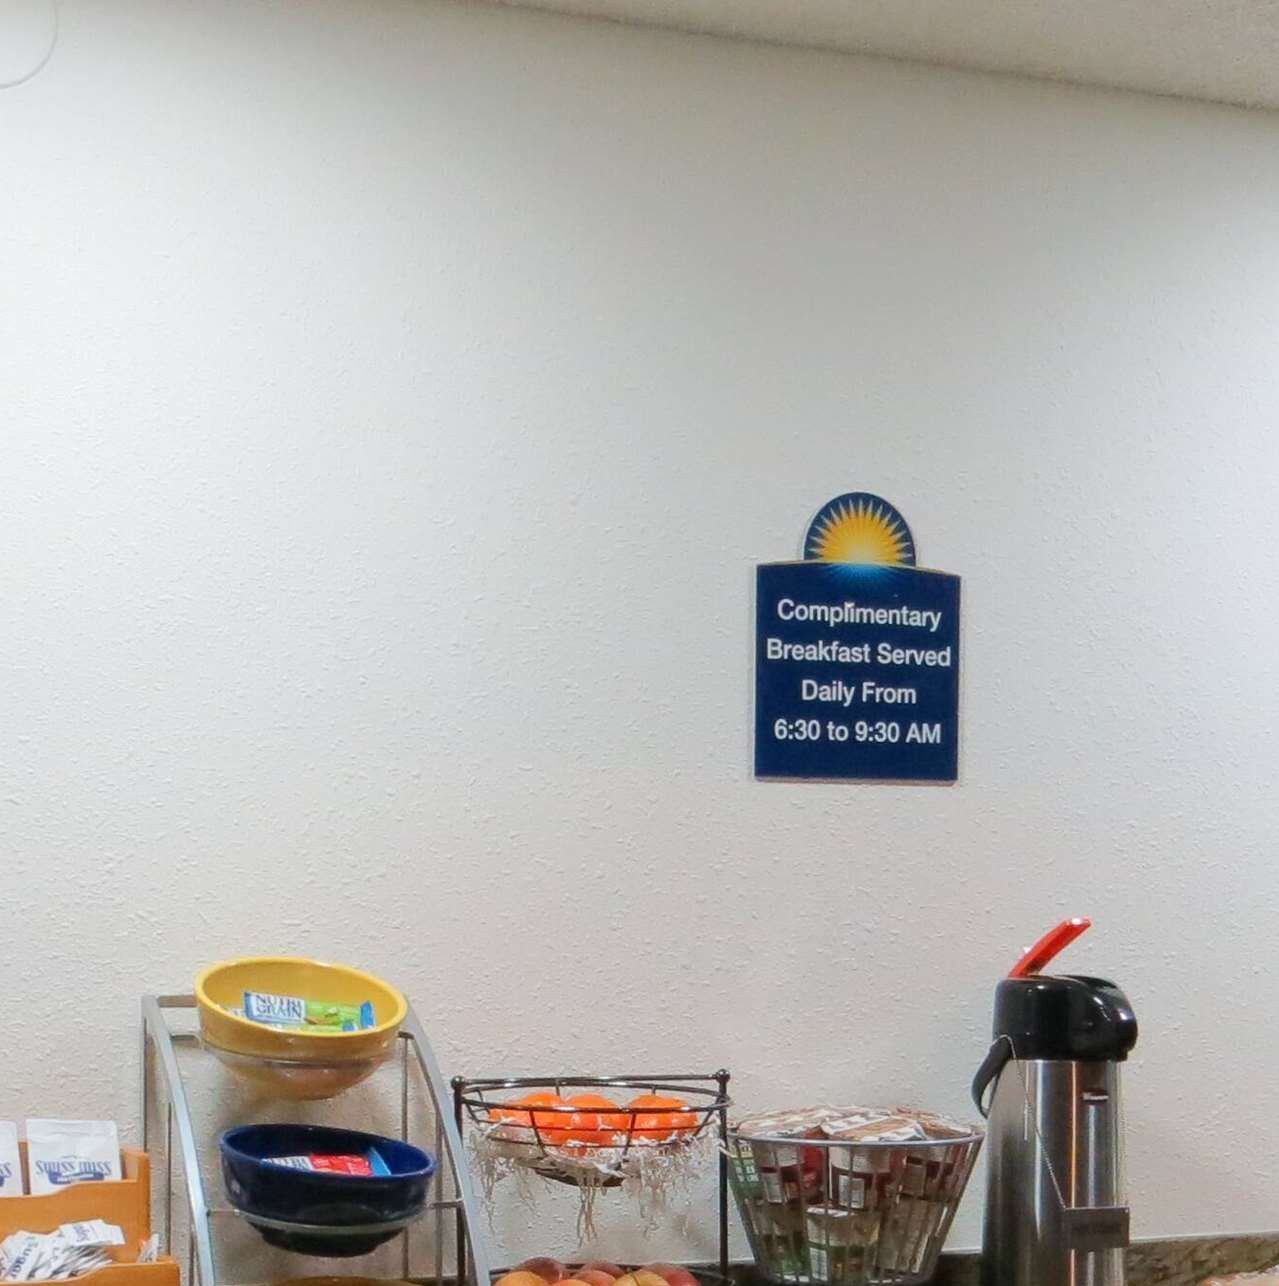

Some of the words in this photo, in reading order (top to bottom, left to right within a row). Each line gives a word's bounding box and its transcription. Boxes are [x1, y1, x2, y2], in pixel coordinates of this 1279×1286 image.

[777, 598, 942, 632] Complimentary
[766, 638, 871, 663] Breakfast
[877, 643, 951, 667] Served
[801, 679, 855, 707] Daily
[862, 682, 917, 704] From
[774, 719, 820, 740] 6:30
[827, 722, 849, 741] to
[855, 721, 900, 743] 9:30
[906, 723, 942, 744] AM
